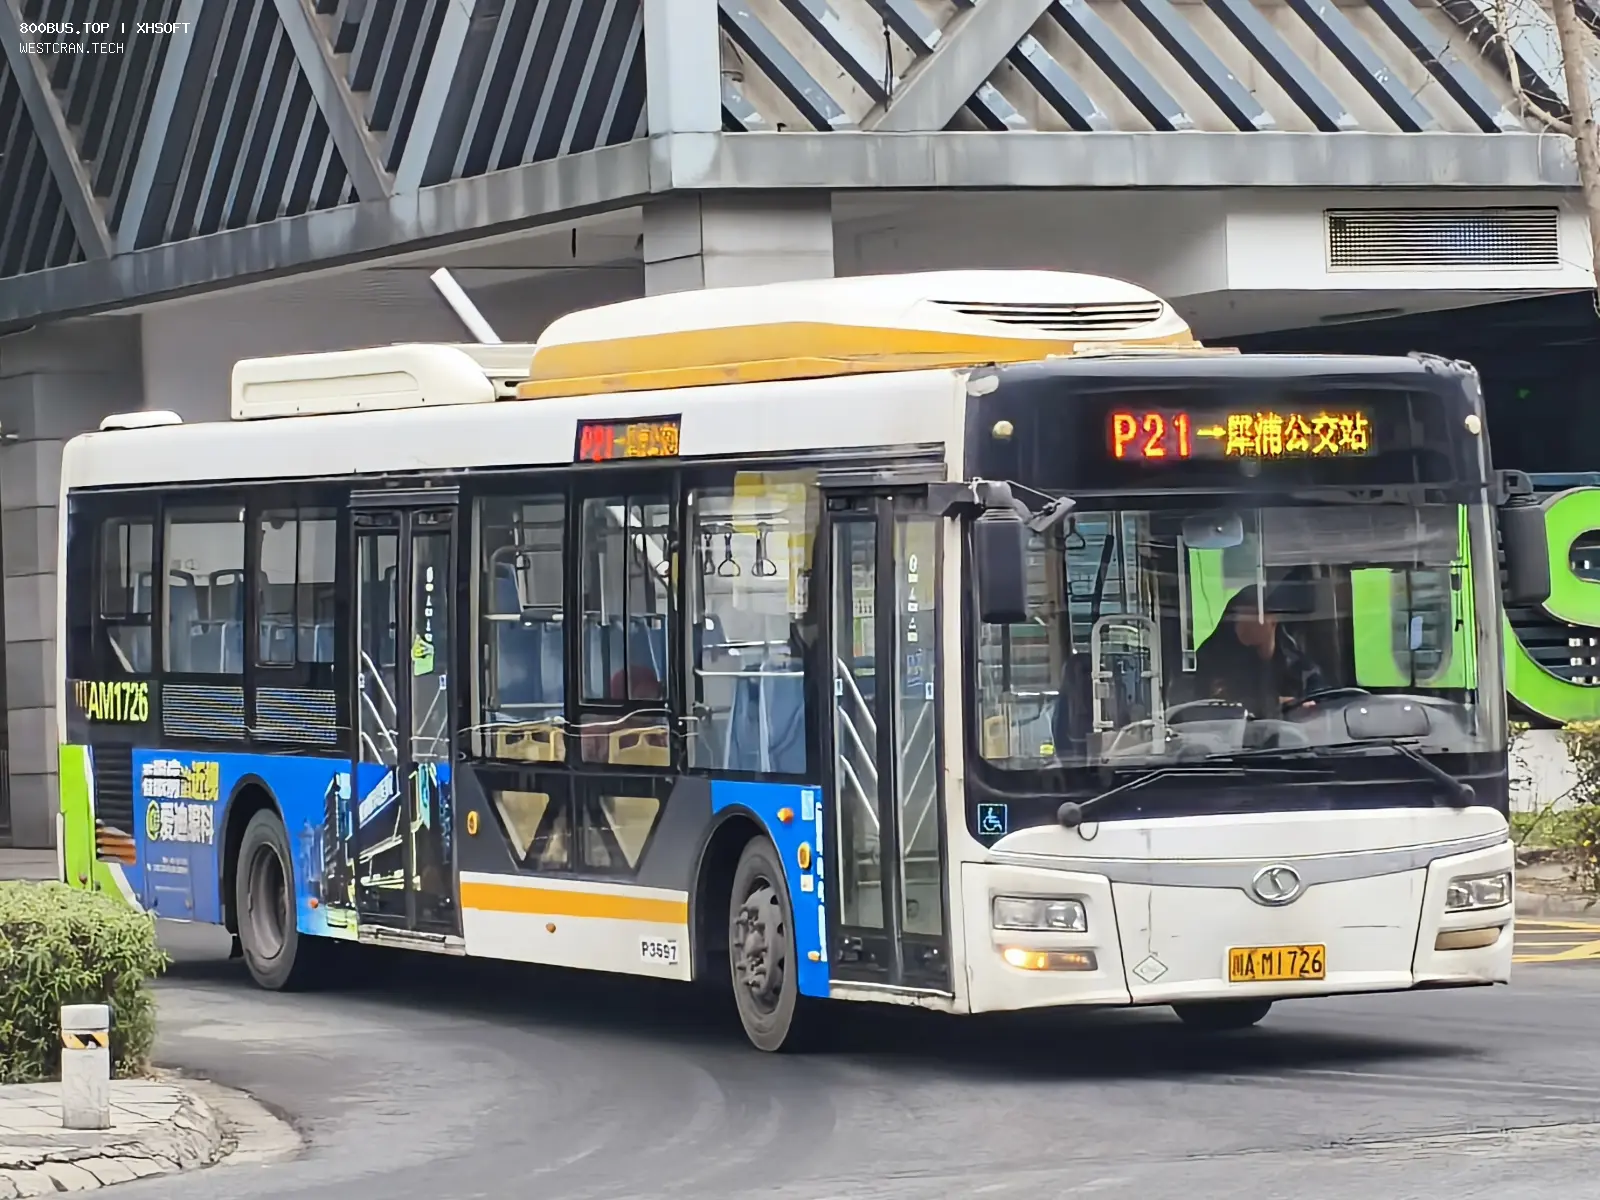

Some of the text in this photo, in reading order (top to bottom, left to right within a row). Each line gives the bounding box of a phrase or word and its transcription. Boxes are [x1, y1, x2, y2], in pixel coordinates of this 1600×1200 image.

[1112, 411, 1368, 458] P21 犀浦公交站
